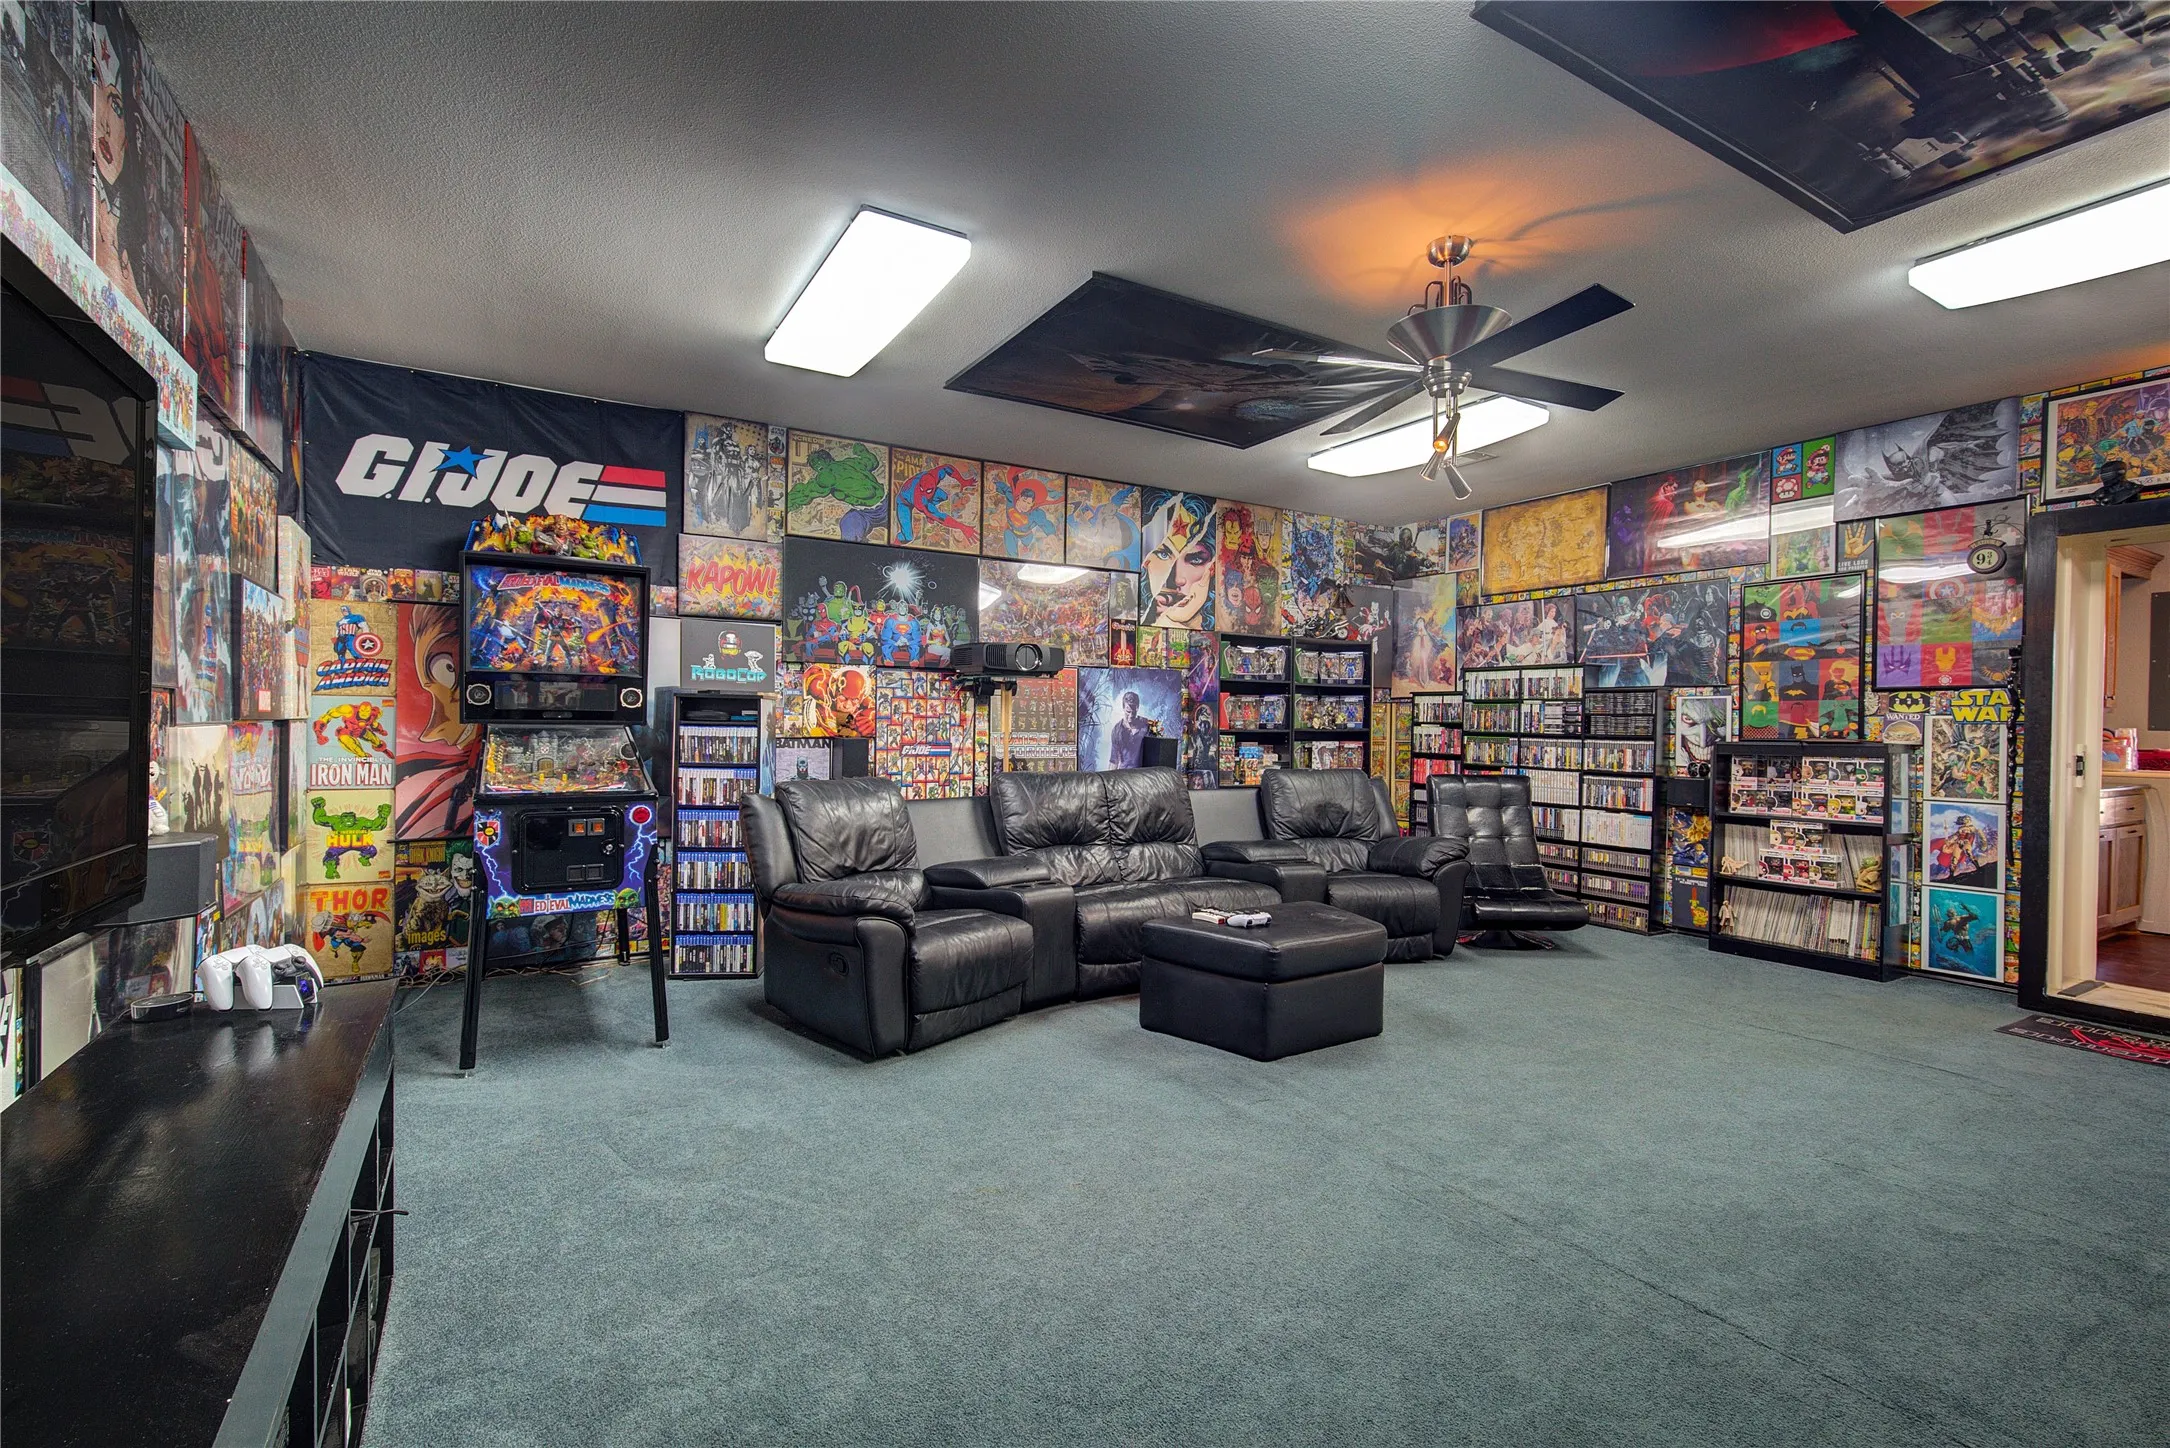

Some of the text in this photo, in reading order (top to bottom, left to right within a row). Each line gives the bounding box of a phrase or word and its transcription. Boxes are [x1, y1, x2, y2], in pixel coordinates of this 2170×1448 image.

[686, 560, 777, 598] KAPOW!
[315, 657, 393, 678] CAPTAIN
[313, 671, 392, 692] AMERICA
[1951, 690, 2025, 706] STA
[776, 739, 831, 748] BATMAN
[310, 763, 393, 786] IRON MAN
[326, 833, 374, 848] HULK
[311, 887, 390, 913] THOR
[519, 892, 616, 916] MEDIEVAL MADNESS
[407, 929, 447, 945] images
